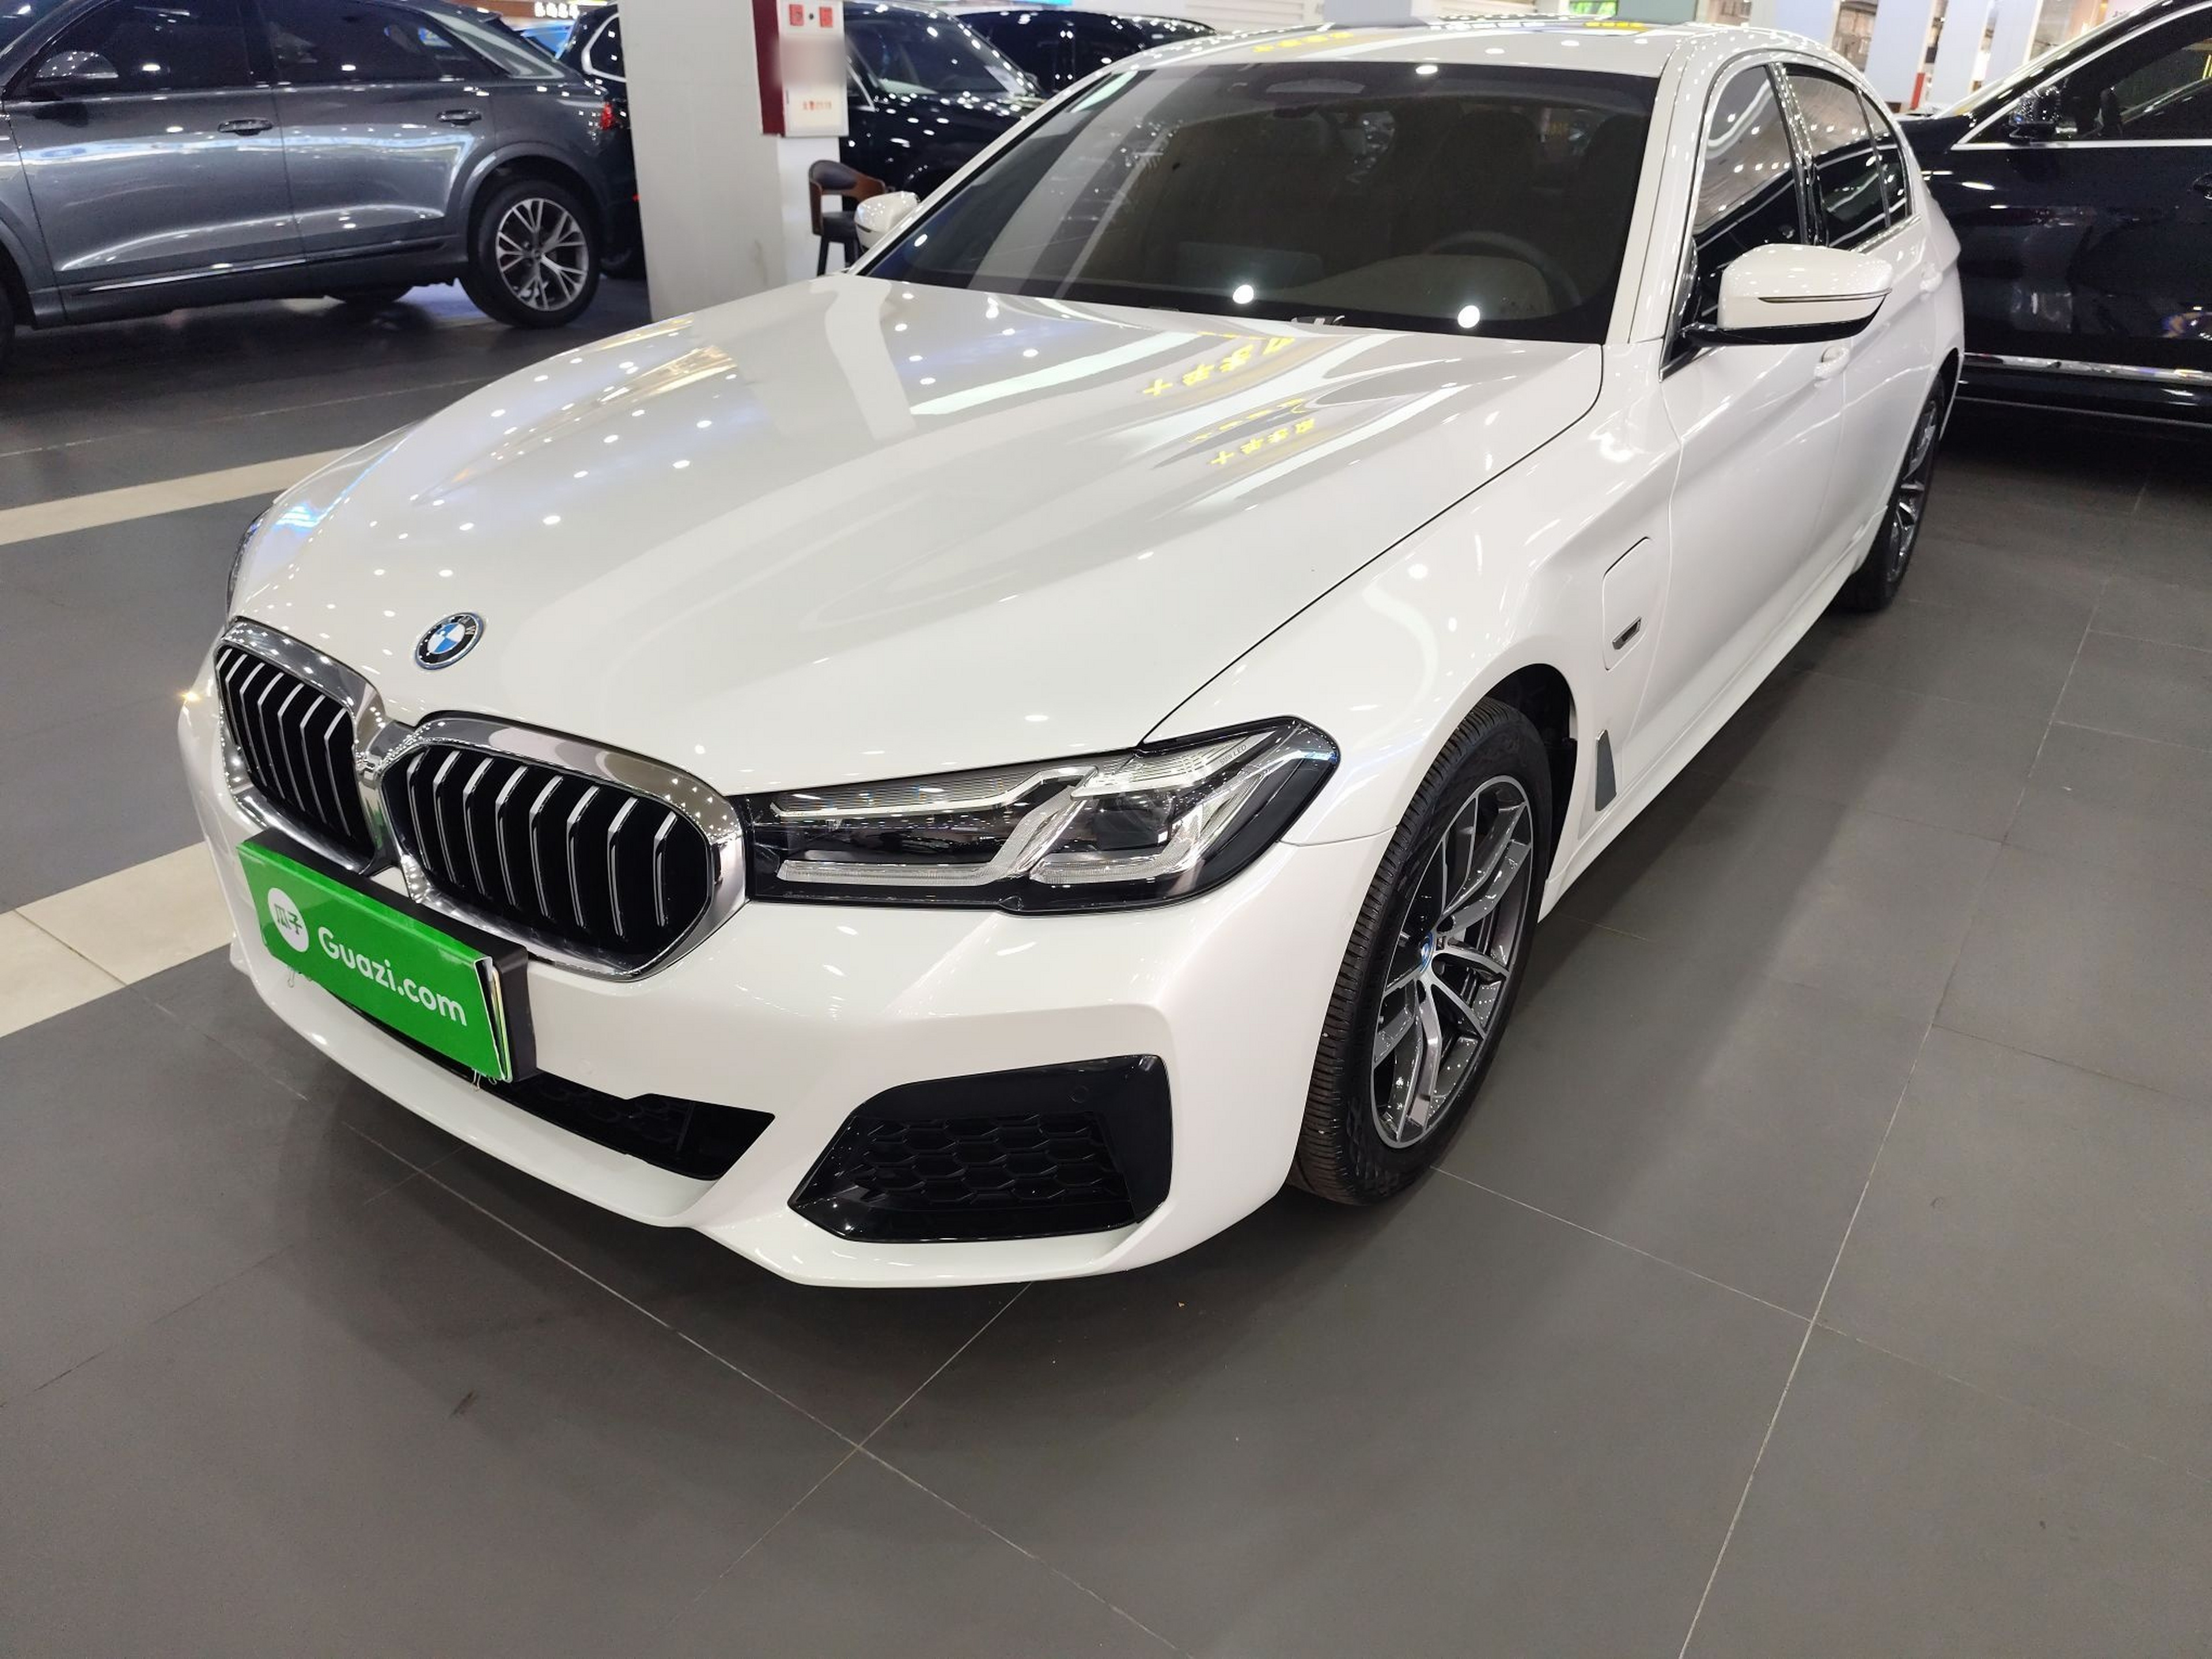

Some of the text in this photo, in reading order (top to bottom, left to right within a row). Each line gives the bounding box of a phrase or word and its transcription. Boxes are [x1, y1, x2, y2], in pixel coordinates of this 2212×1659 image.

[1233, 744, 1247, 756] LED
[274, 903, 303, 935] 瓜子
[318, 926, 467, 1026] Guazi.com
